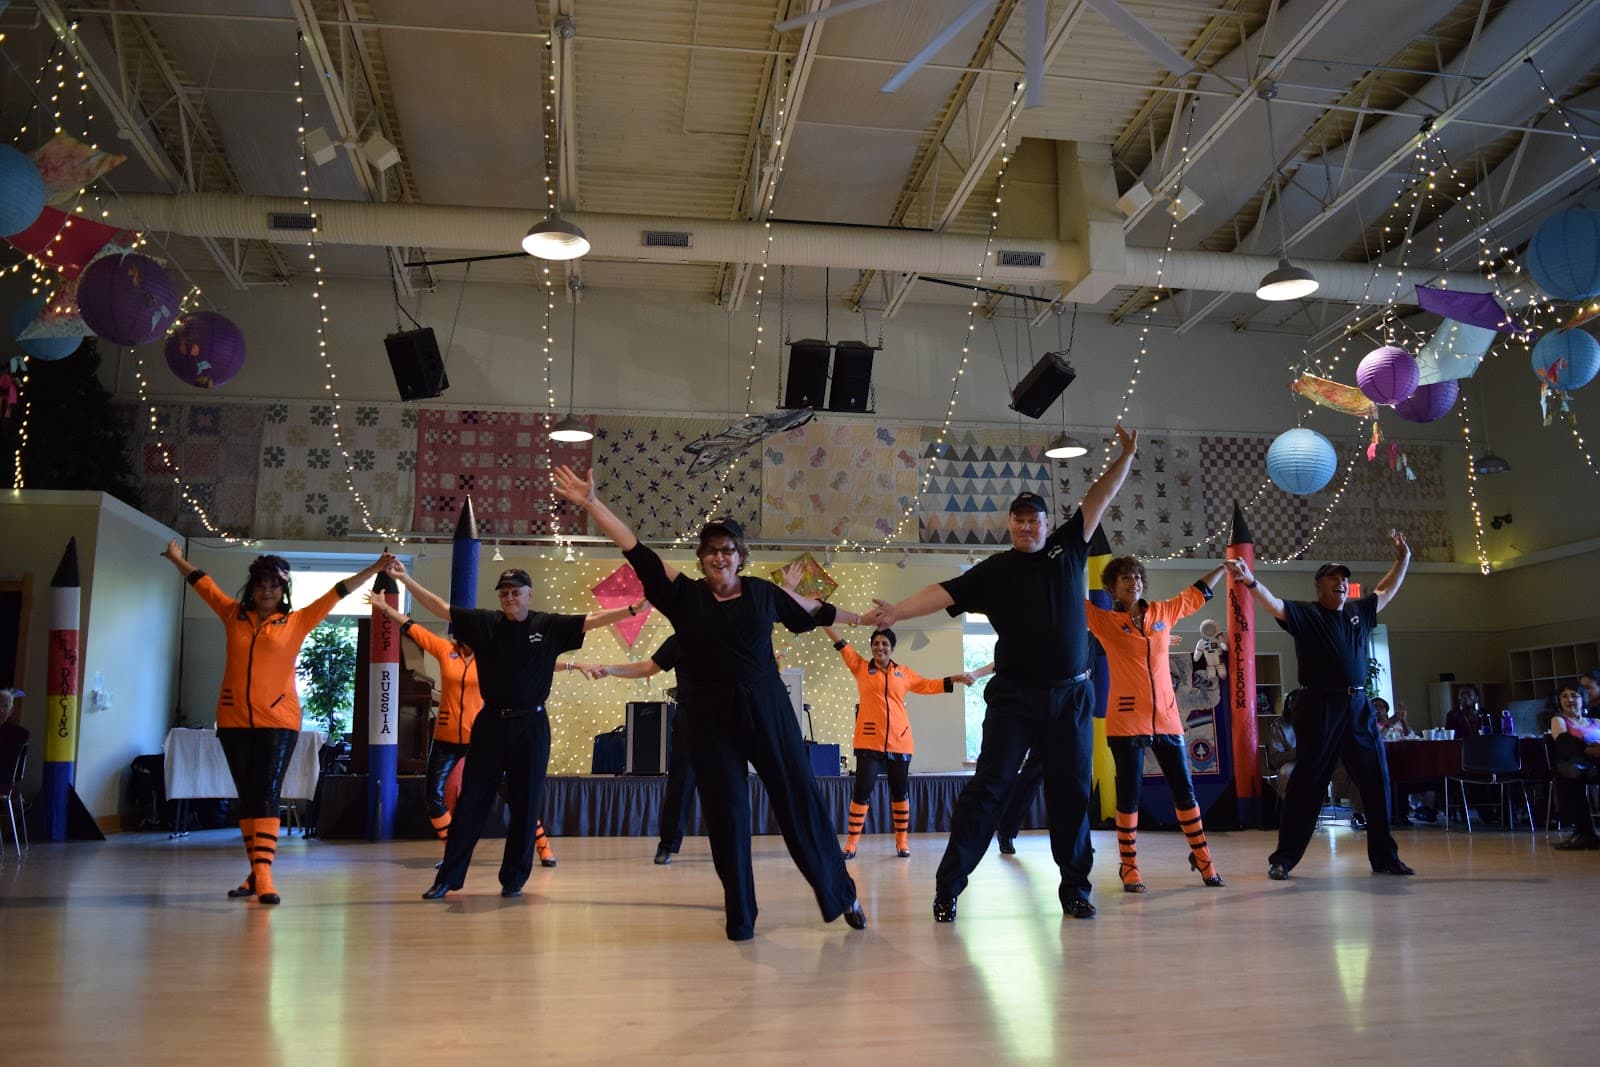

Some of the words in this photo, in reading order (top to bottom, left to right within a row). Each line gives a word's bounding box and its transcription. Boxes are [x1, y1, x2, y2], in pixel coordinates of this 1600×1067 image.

[1229, 588, 1248, 632] ARBOR
[381, 670, 391, 734] RUSSIA
[1234, 633, 1246, 708] BALLROOM
